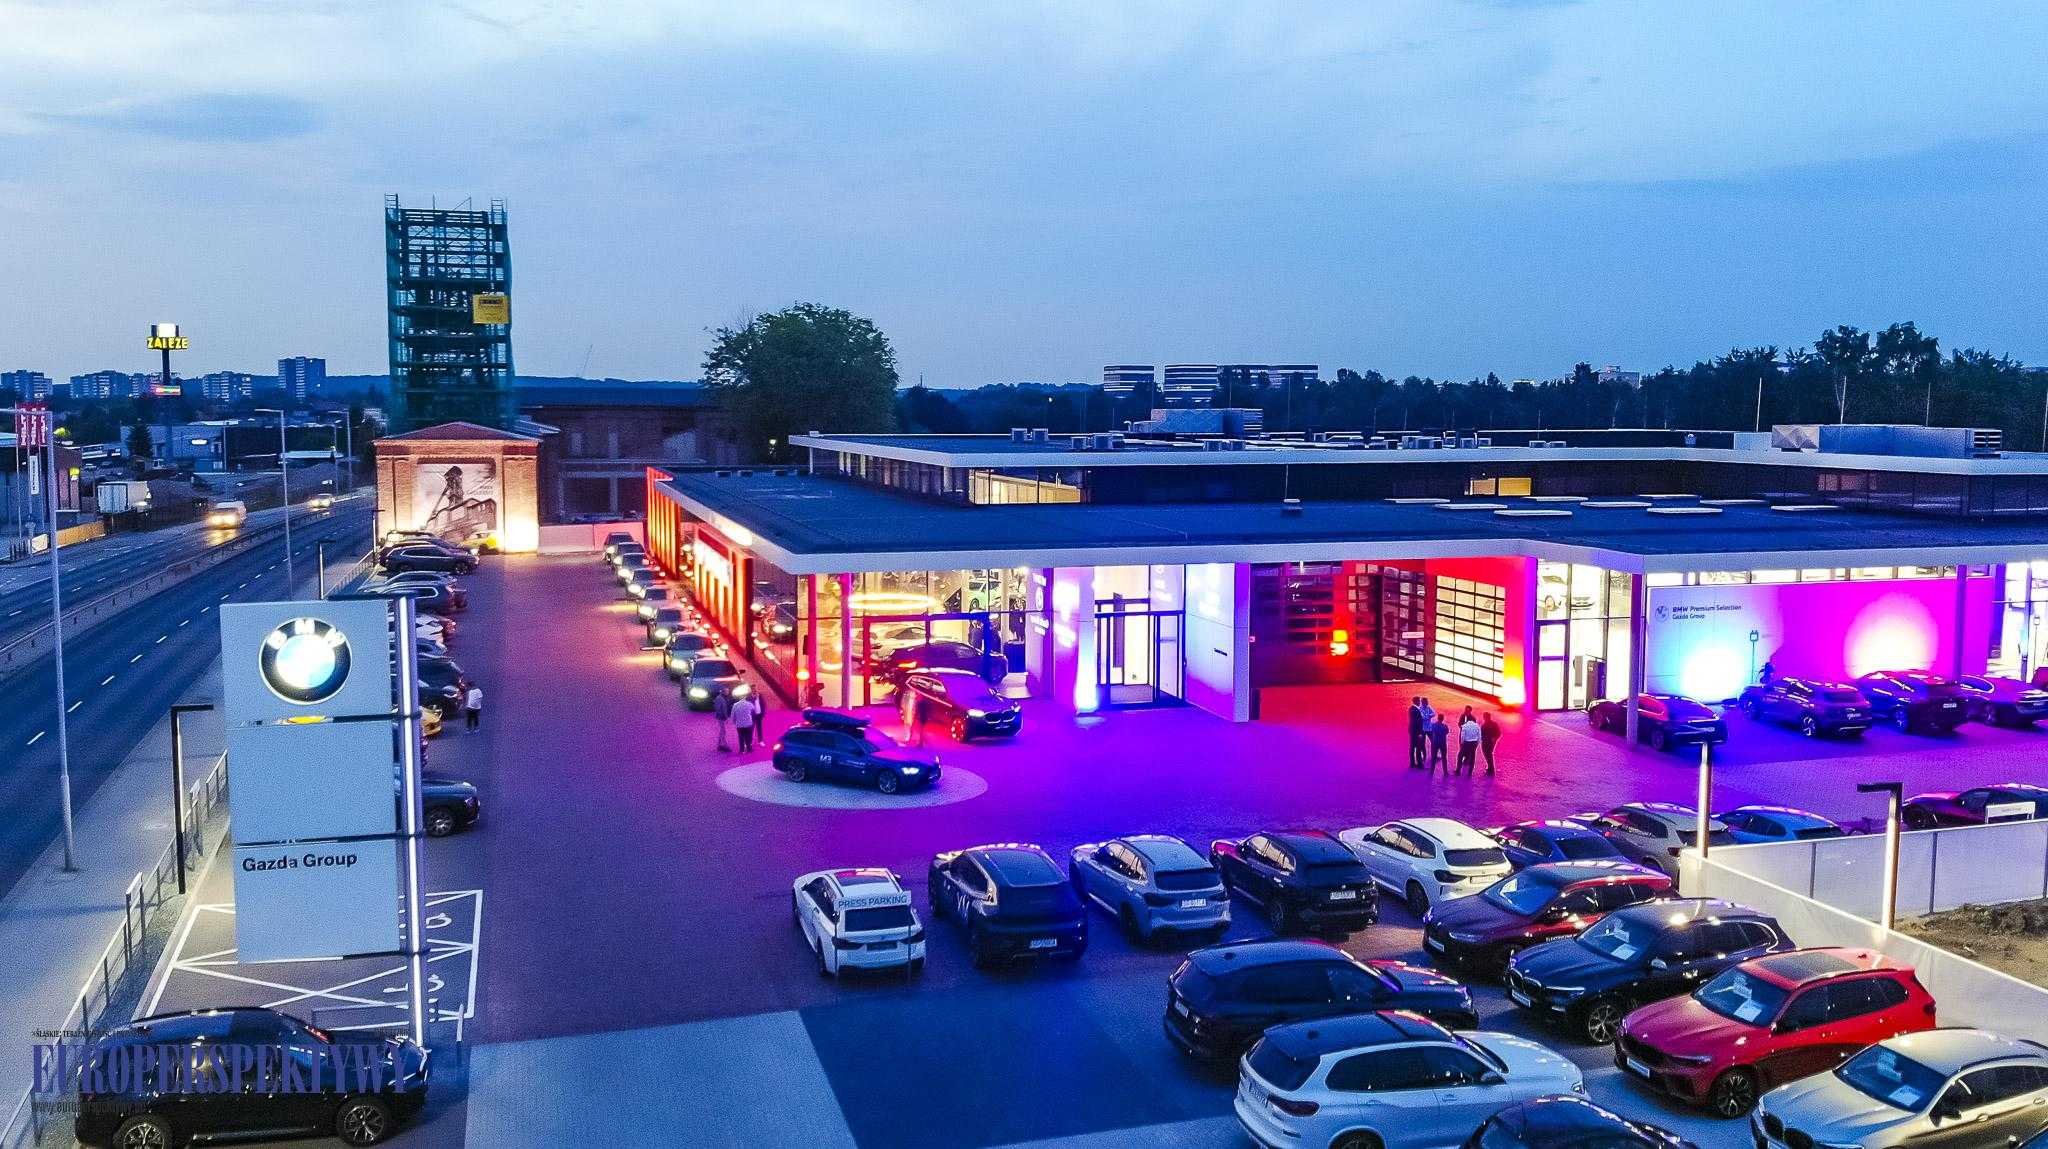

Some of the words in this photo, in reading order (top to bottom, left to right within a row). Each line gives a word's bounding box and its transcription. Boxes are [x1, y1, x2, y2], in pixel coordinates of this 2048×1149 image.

[1690, 605, 1715, 613] Premium
[242, 855, 298, 872] Gazda
[303, 853, 358, 869] Group
[838, 898, 868, 908] PRESS
[868, 894, 908, 906] PARKING
